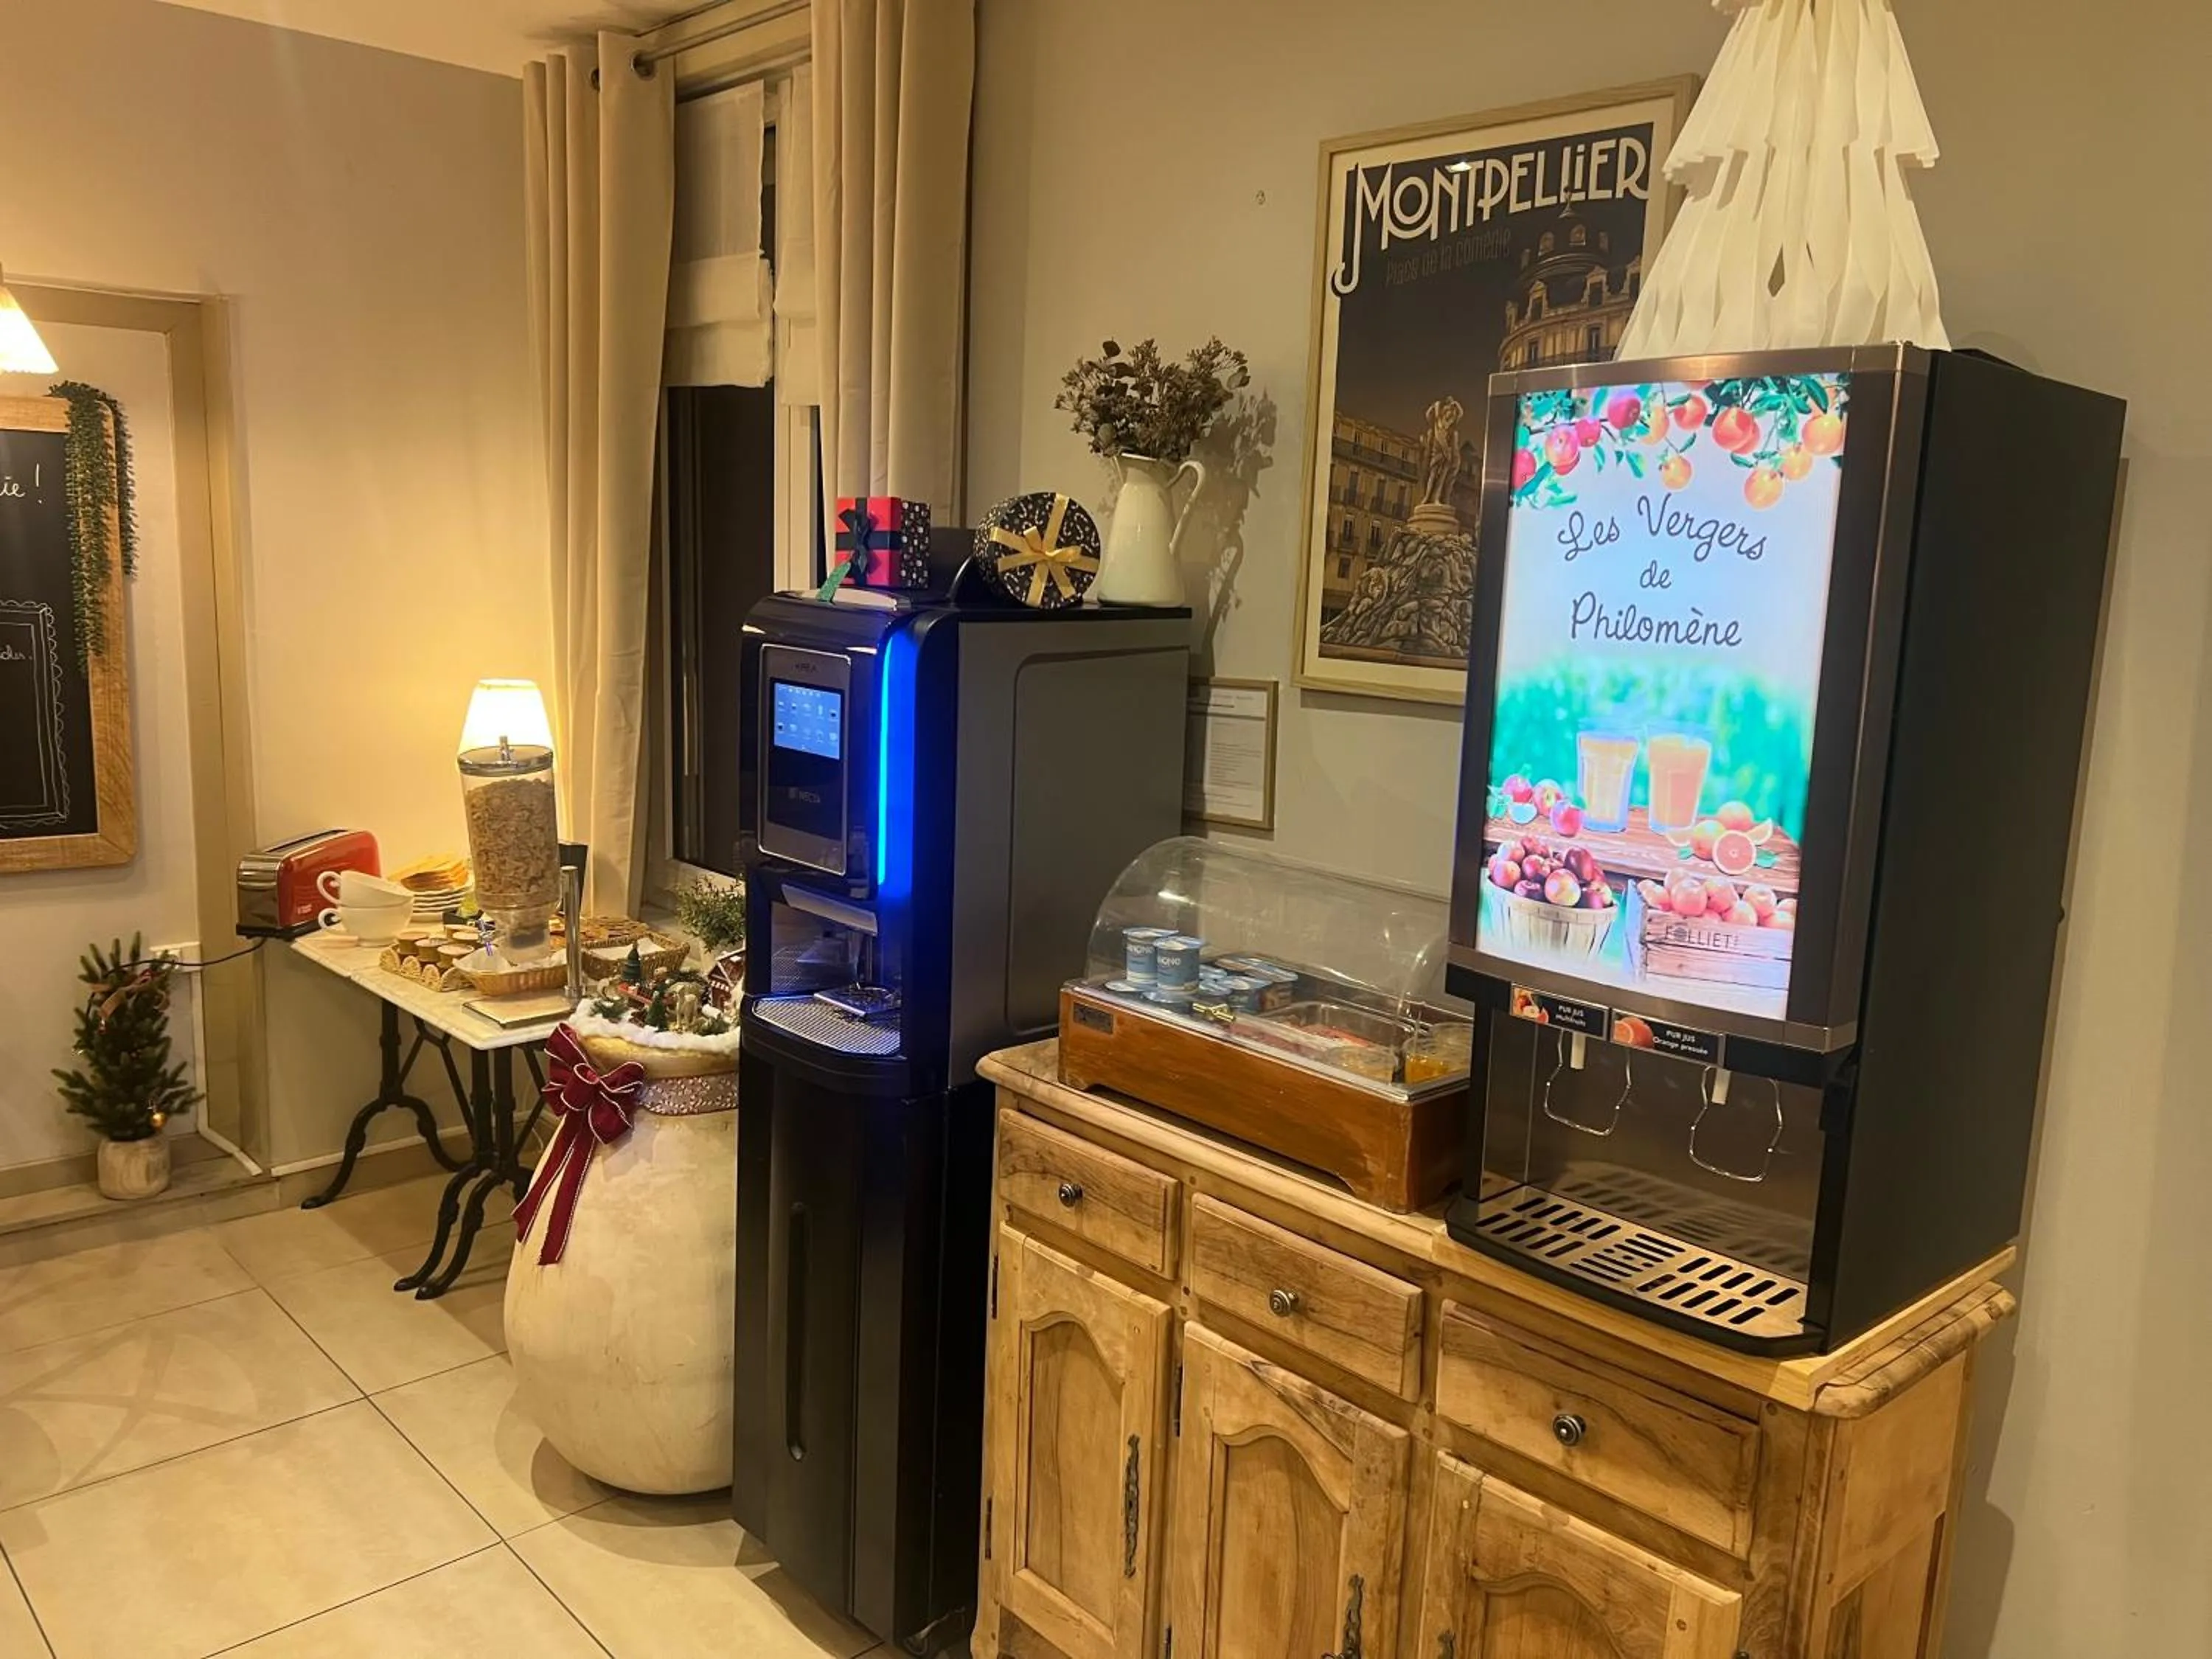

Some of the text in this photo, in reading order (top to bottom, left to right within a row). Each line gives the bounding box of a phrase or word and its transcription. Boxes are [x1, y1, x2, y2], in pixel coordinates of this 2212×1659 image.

[1557, 492, 1768, 562] Les Vergers
[1639, 559, 1672, 588] de
[1570, 591, 1742, 647] Philomène
[1652, 1036, 1679, 1048] Orange
[1666, 1030, 1695, 1043] PUR JUS
